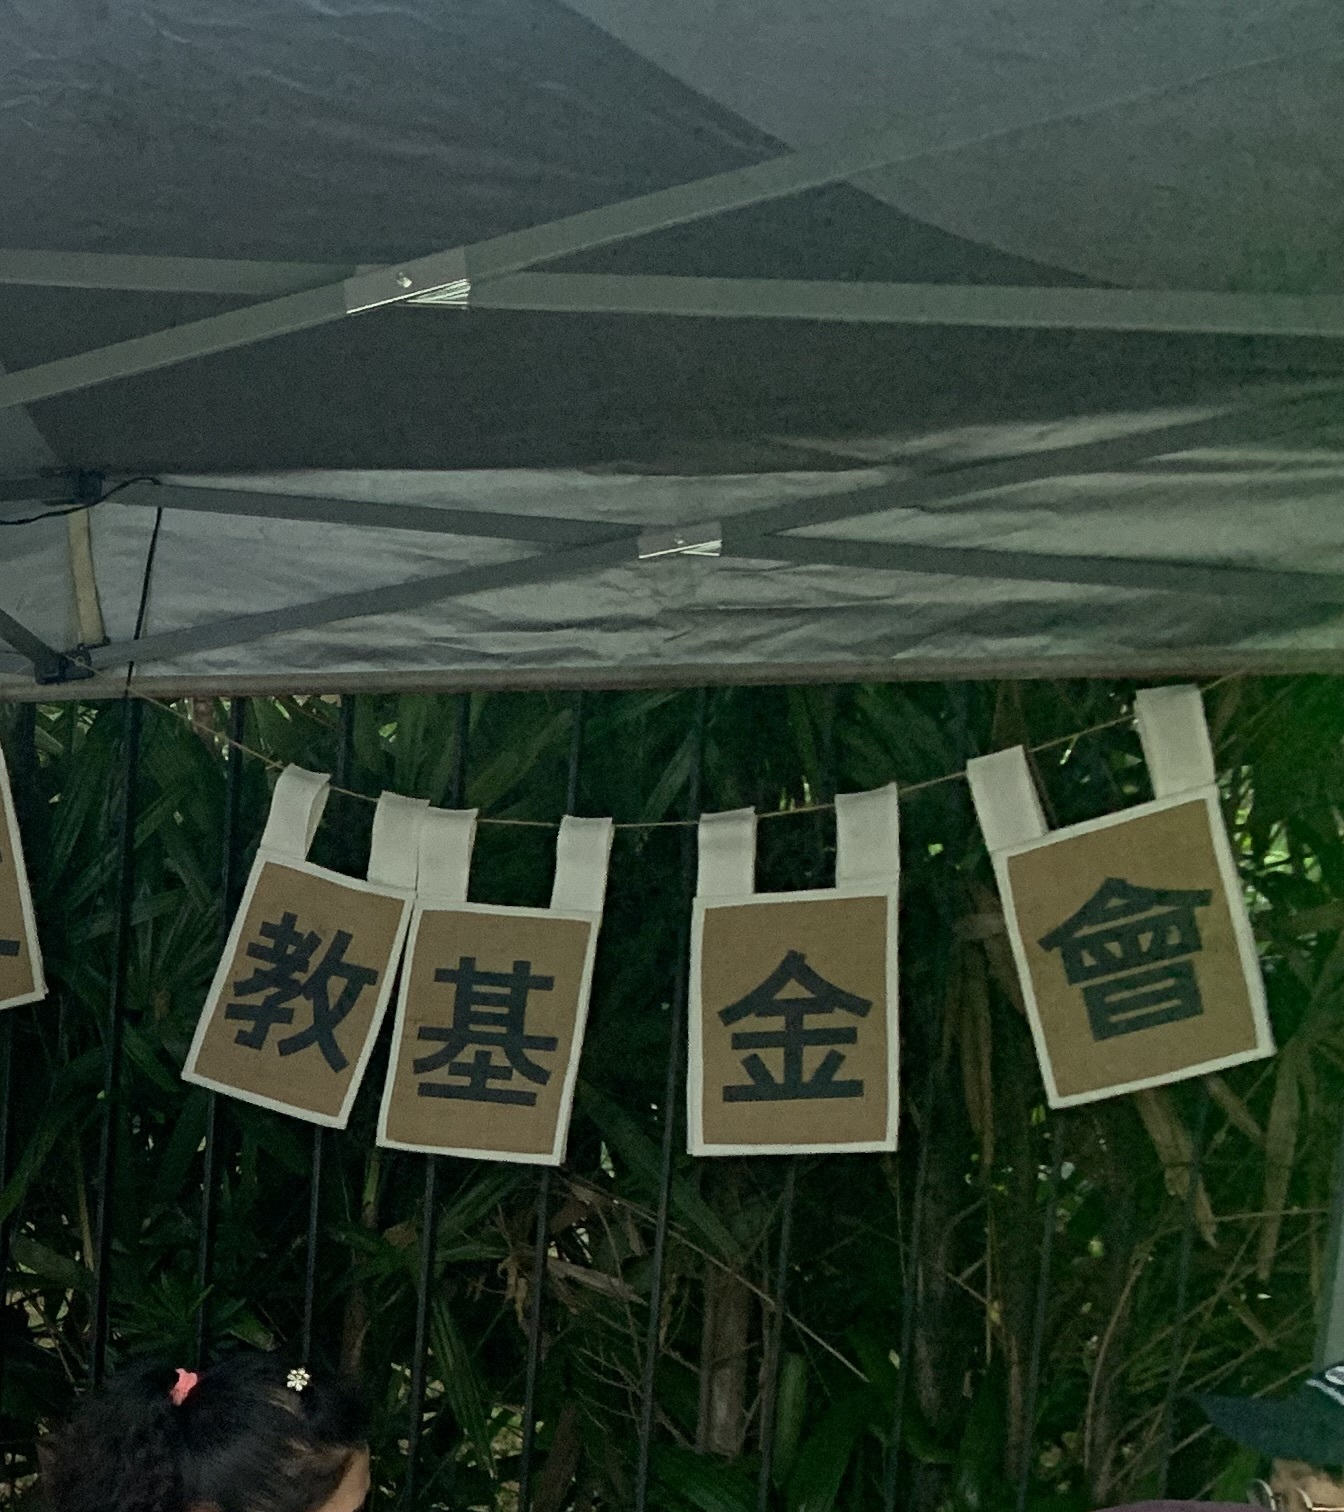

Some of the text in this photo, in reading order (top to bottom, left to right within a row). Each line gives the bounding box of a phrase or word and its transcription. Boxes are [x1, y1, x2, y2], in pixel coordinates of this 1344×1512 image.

[224, 911, 379, 1074] 教
[412, 956, 558, 1109] 基
[717, 949, 875, 1104] 金
[1037, 876, 1214, 1043] 會
